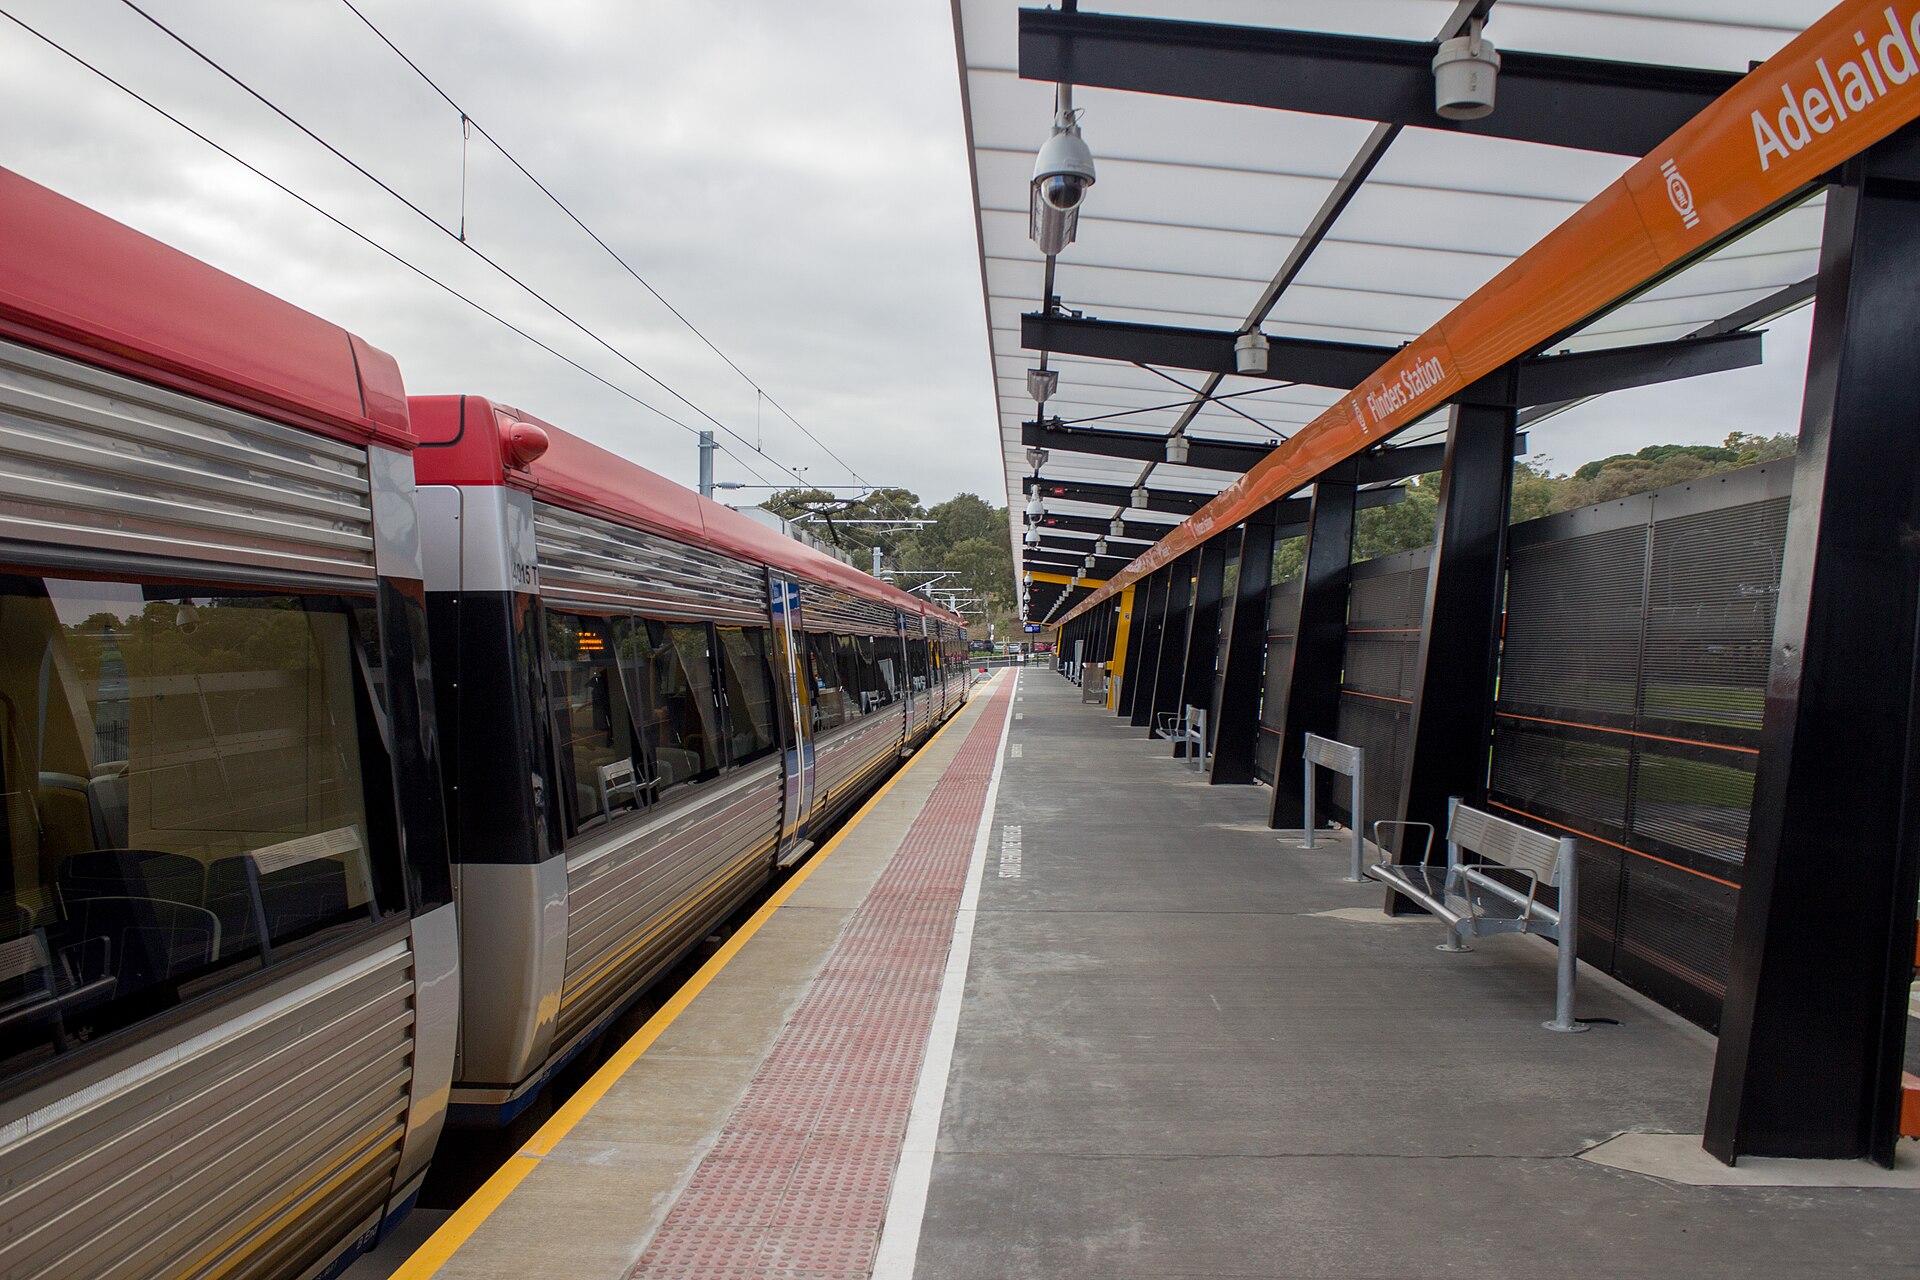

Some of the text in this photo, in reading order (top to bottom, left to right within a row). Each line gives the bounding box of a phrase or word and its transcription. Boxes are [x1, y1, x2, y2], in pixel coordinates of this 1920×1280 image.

[1366, 356, 1445, 423] Flinders Station
[512, 562, 531, 585] 4015
